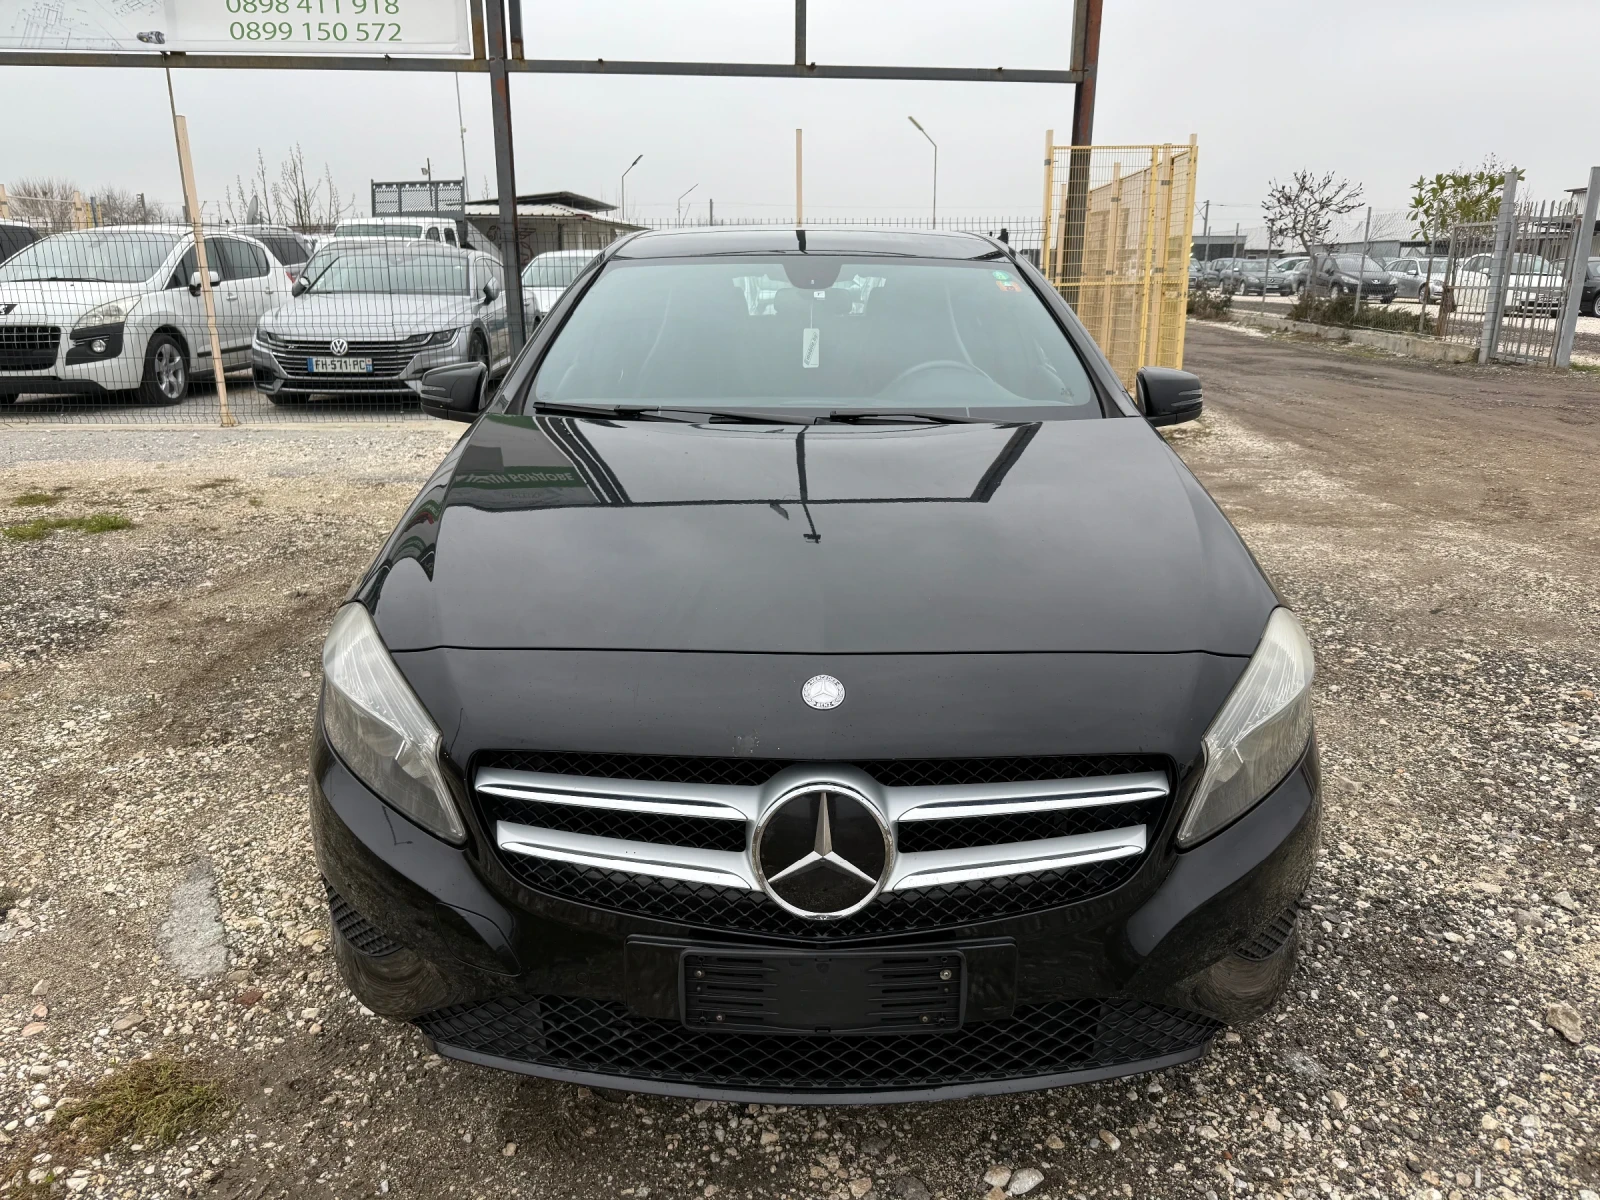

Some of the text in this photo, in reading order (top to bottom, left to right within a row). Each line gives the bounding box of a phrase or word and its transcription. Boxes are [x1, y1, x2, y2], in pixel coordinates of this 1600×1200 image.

[226, 0, 400, 14] 0898 411 918
[230, 21, 402, 41] 0899 150 572
[314, 359, 366, 371] FH-571-PC
